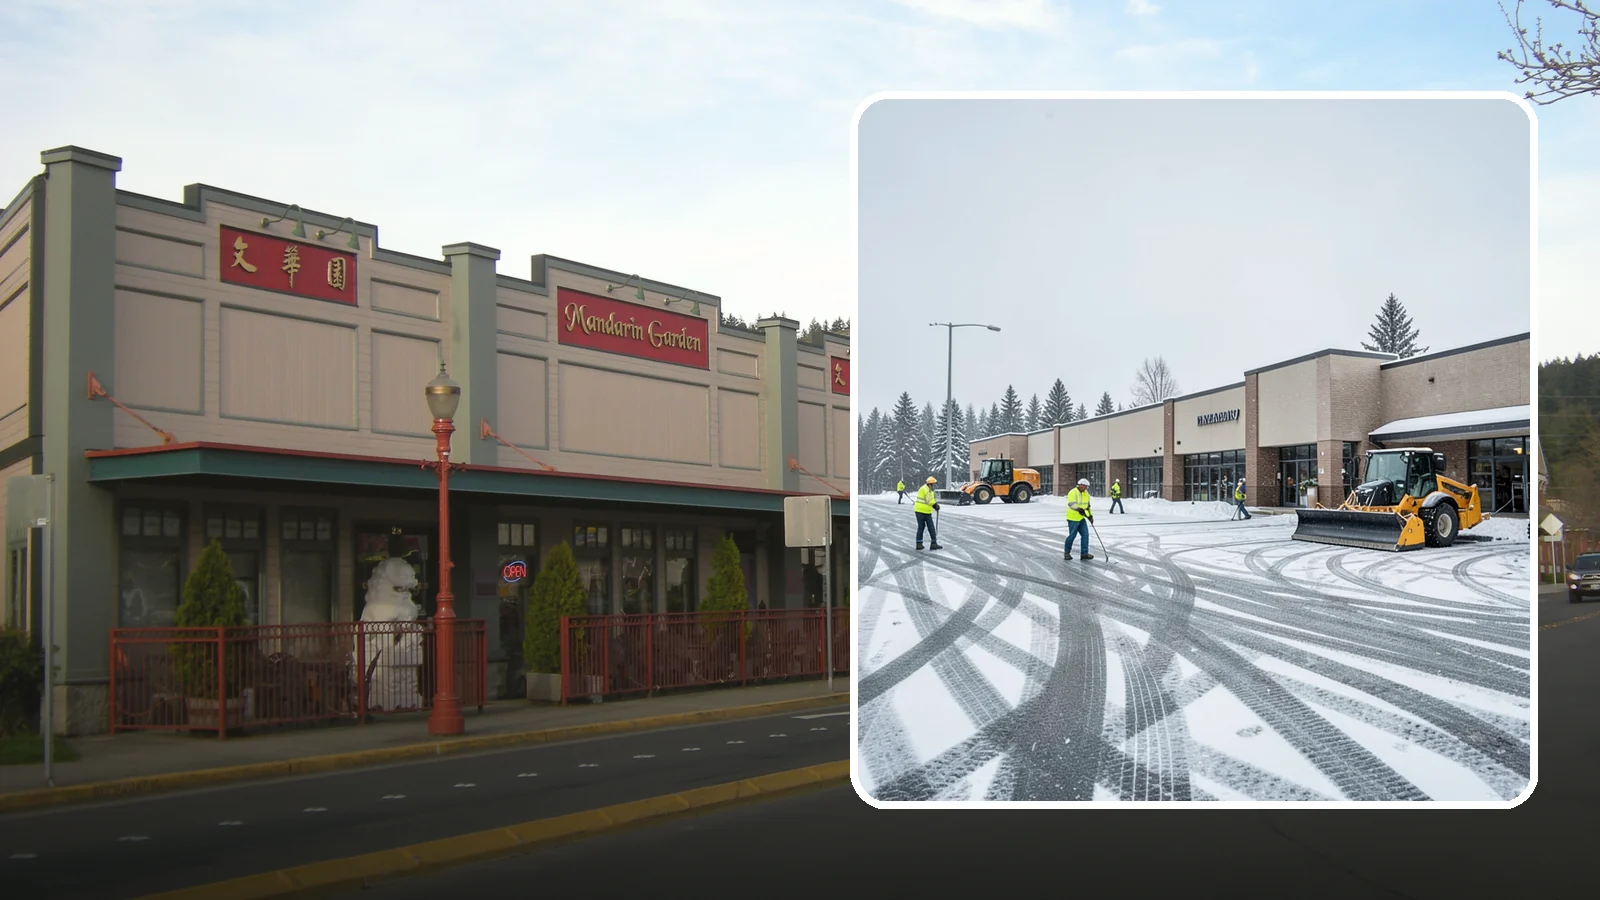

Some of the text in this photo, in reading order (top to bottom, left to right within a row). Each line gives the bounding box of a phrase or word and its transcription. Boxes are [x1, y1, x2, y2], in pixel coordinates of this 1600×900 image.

[231, 235, 346, 291] 文華園
[564, 302, 701, 352] Mandarin Garden
[835, 363, 846, 386] 文
[503, 565, 527, 578] OPEN
